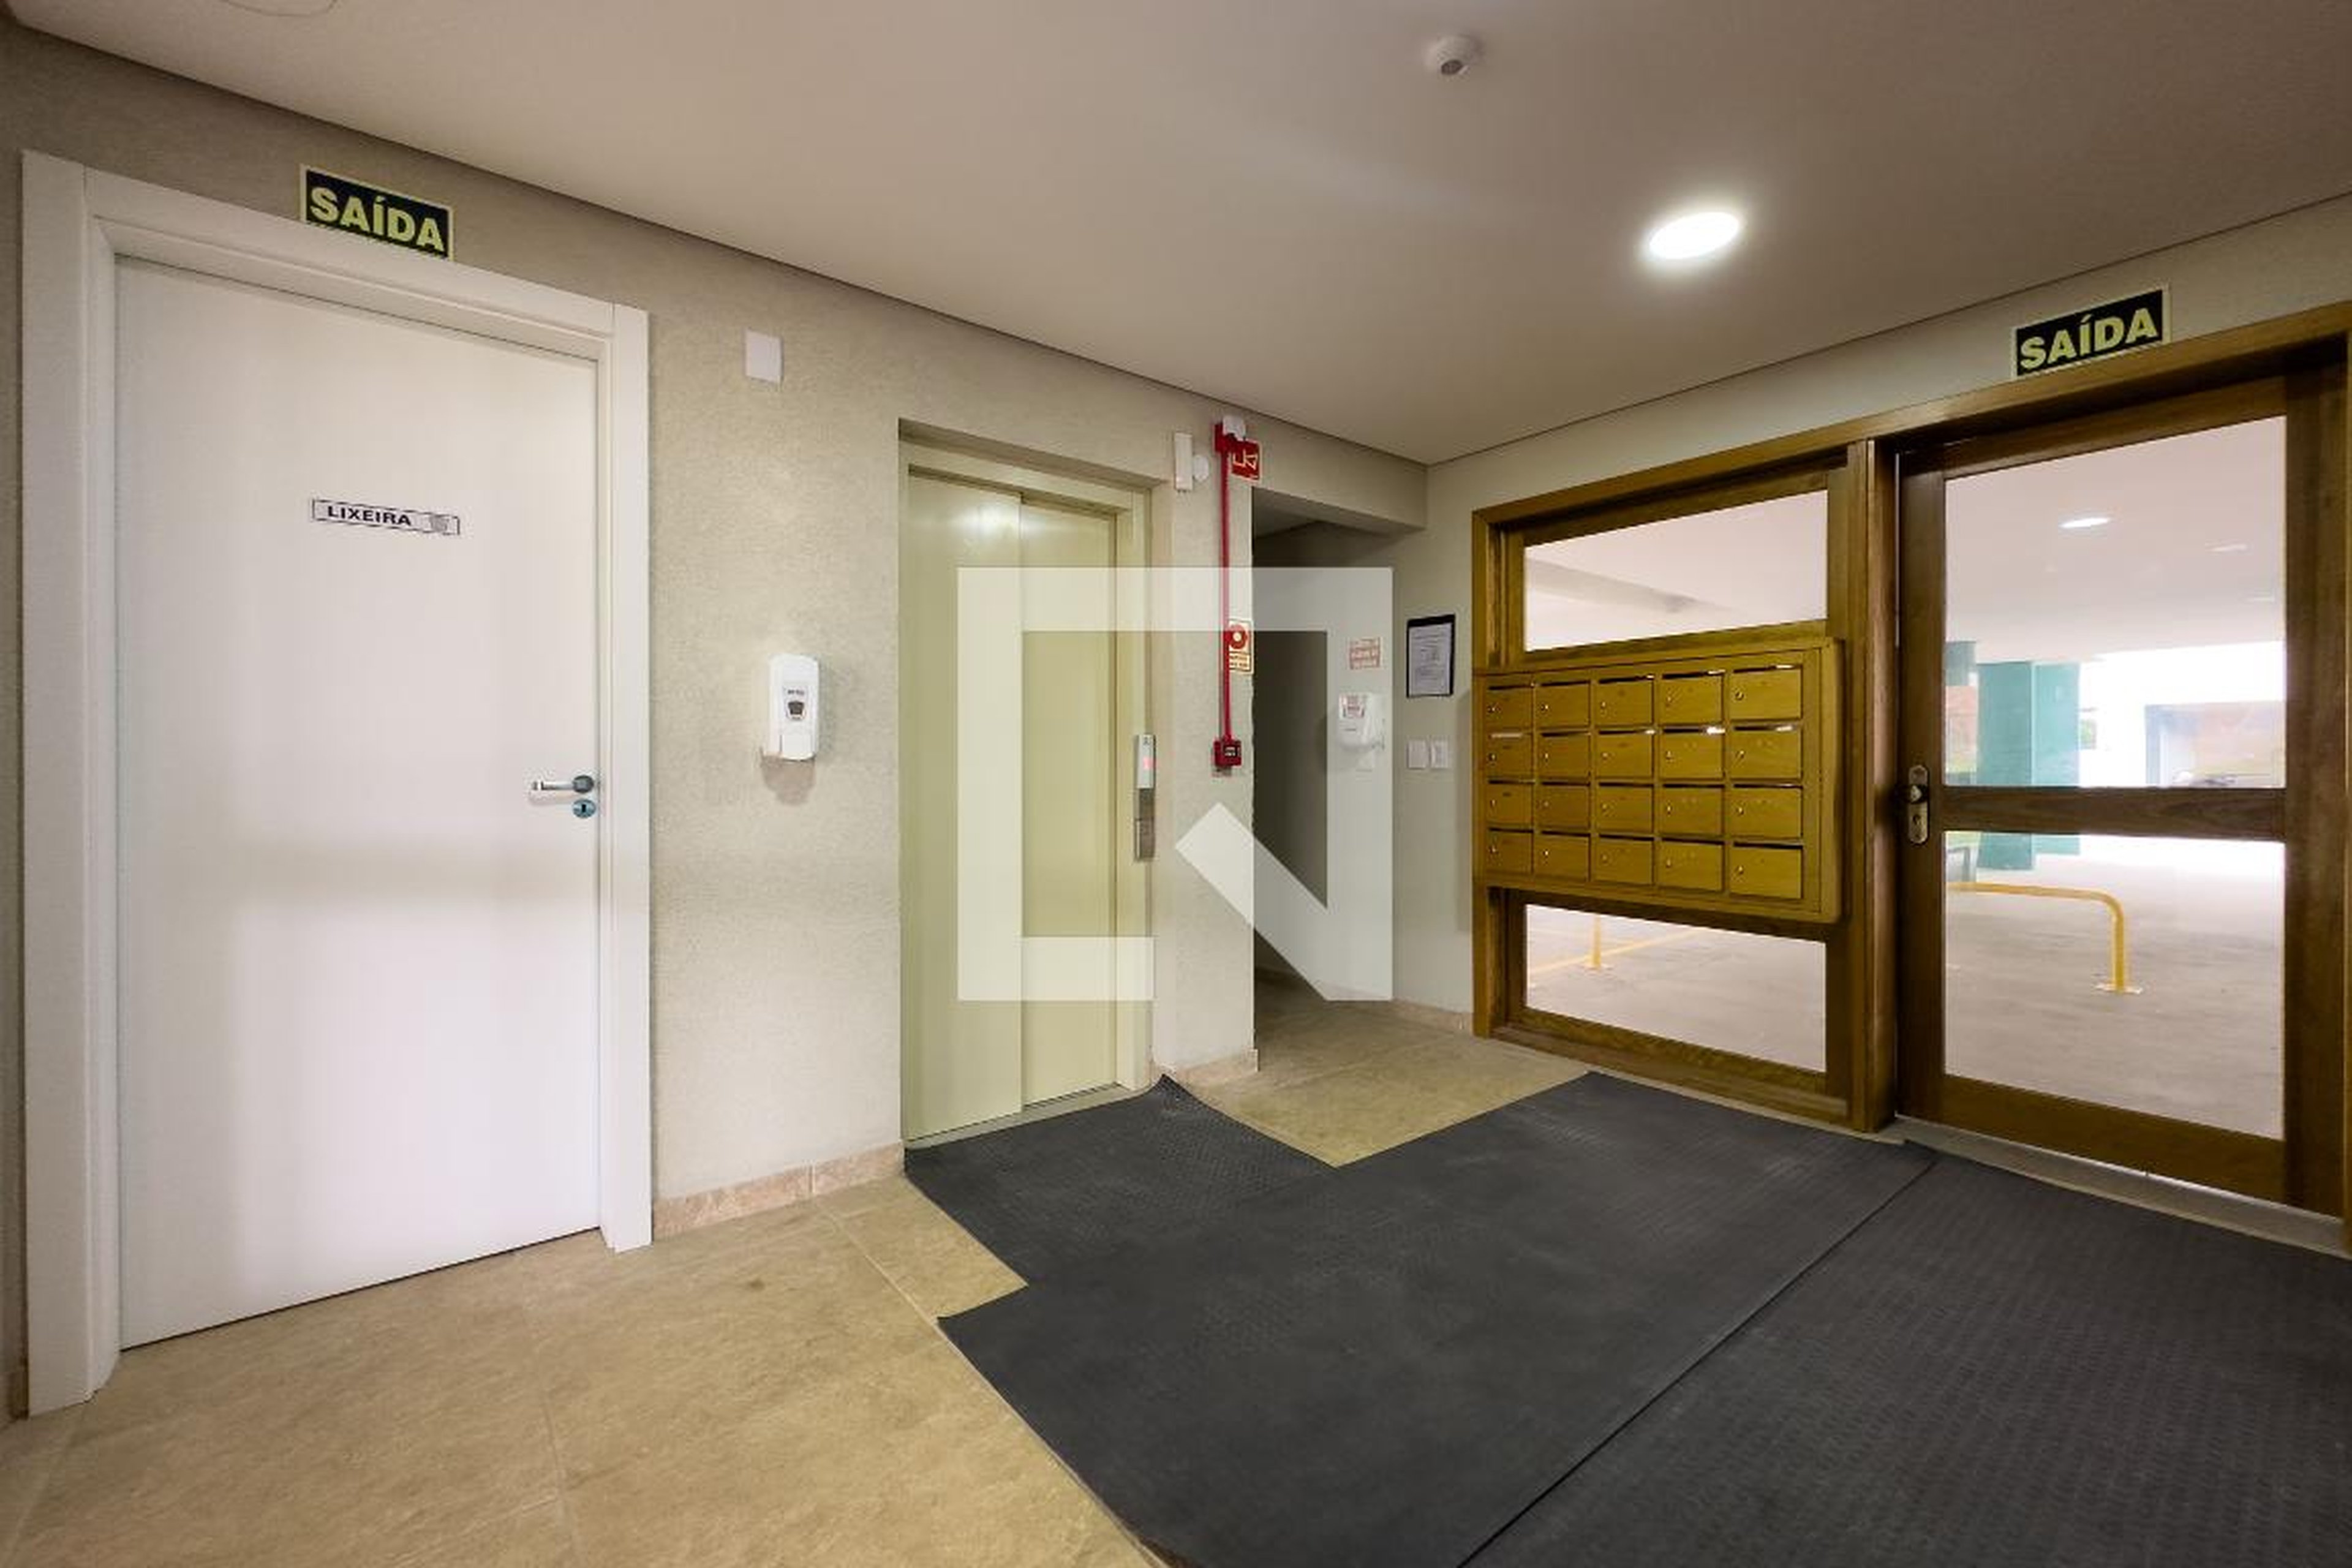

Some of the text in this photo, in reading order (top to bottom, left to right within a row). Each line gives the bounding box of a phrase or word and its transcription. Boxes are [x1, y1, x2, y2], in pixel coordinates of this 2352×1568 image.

[310, 187, 445, 252] SAÍDA
[2021, 307, 2158, 369] SAÍDA
[327, 505, 412, 526] LIXEIRA
